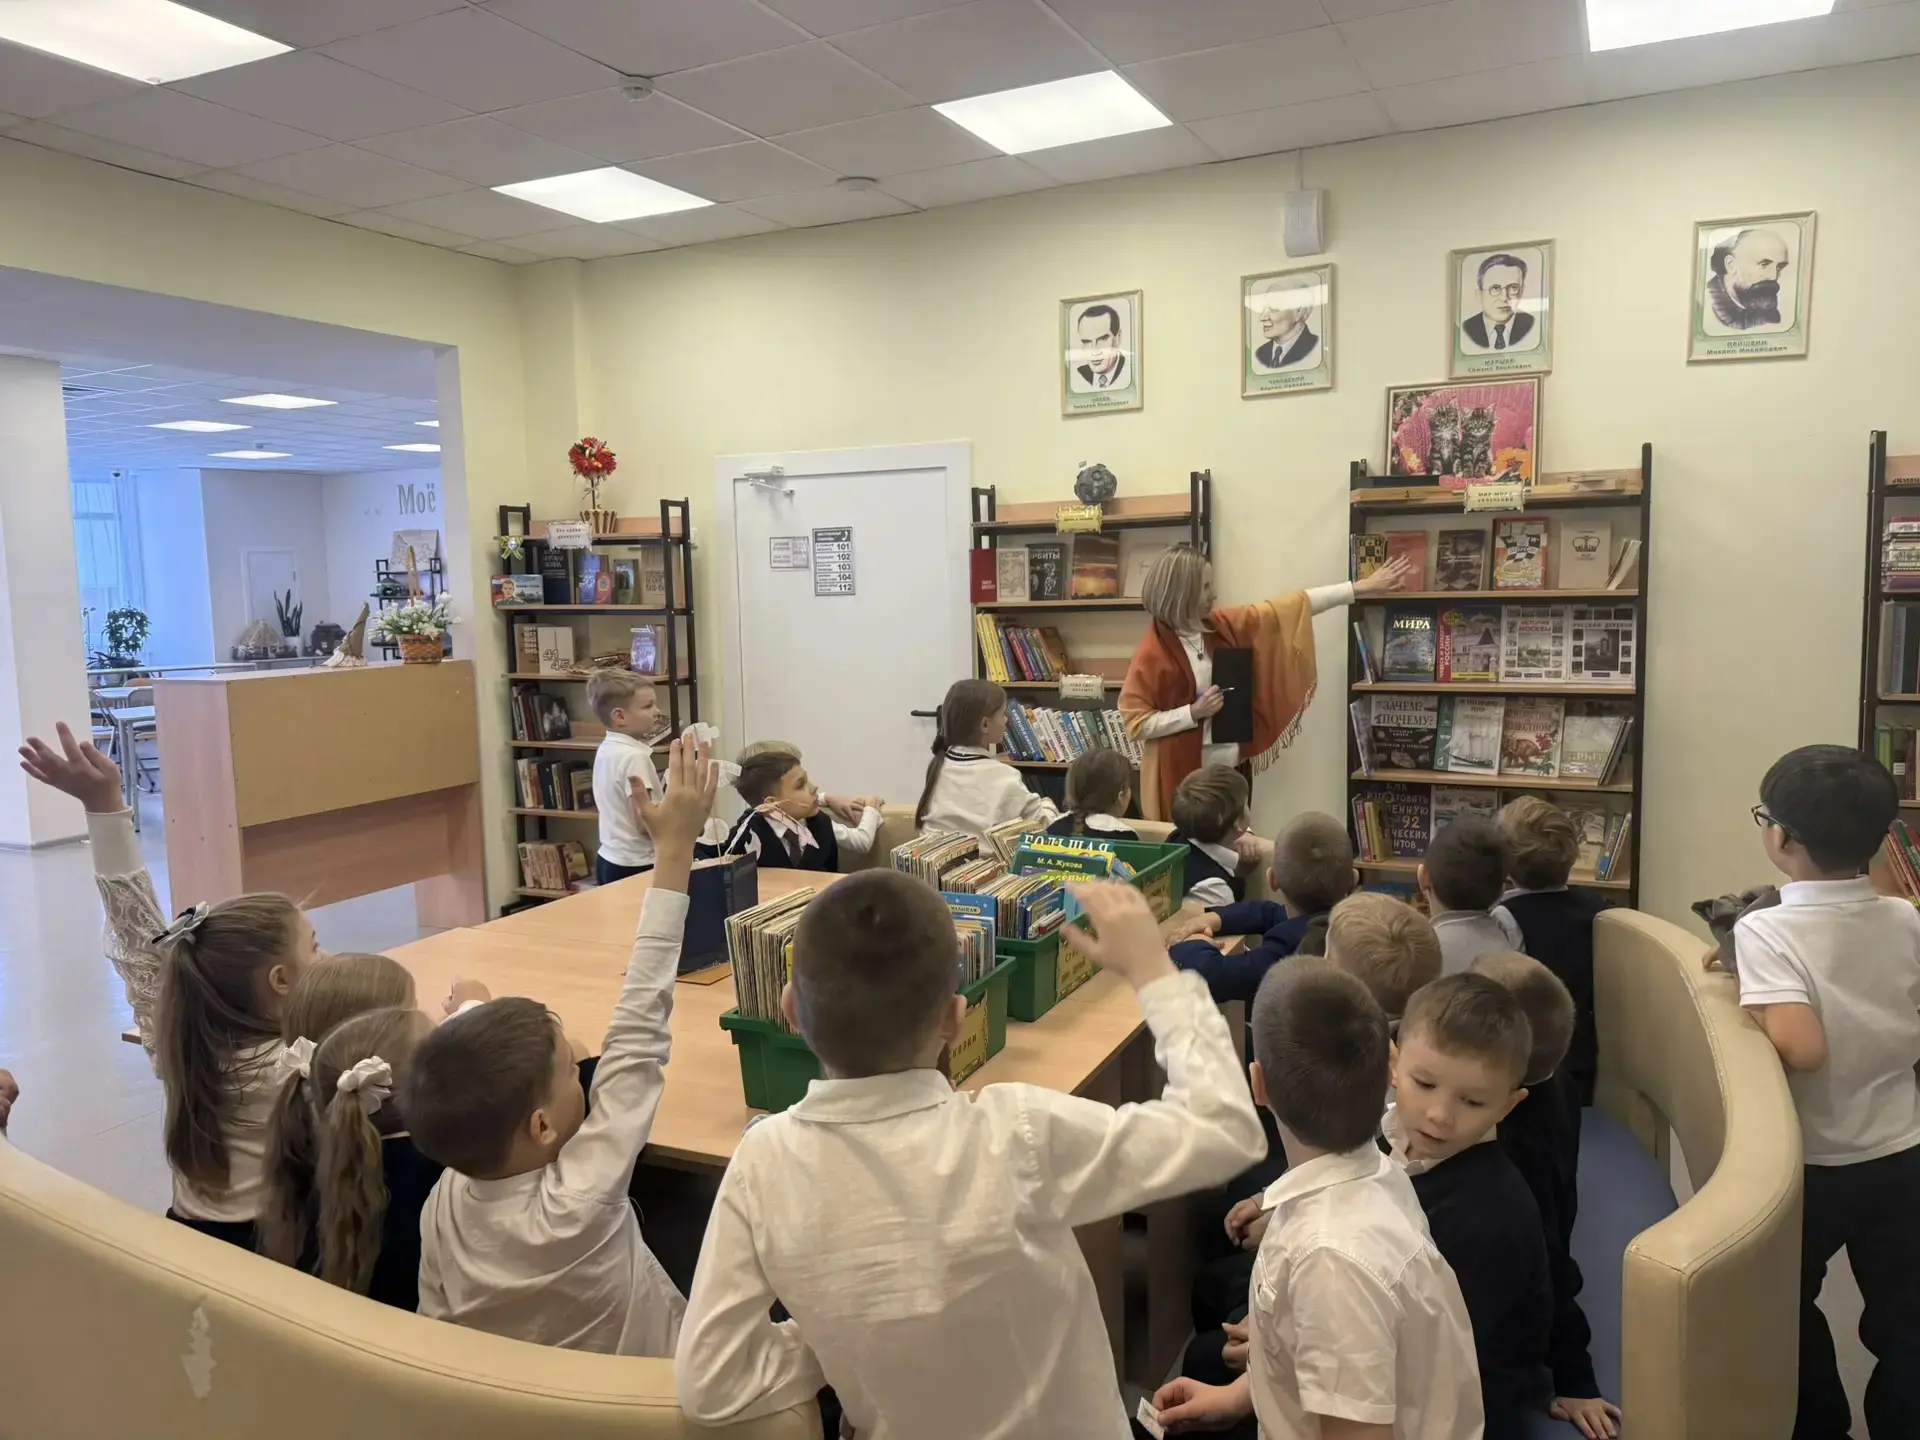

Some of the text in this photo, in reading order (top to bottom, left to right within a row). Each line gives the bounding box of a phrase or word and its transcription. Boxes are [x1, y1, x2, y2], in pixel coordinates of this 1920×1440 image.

[397, 483, 436, 515] Моё
[1031, 552, 1061, 560] РБИТЫ
[838, 573, 852, 581] 104
[839, 583, 852, 591] 112
[1393, 620, 1431, 629] МИРА
[543, 649, 559, 661] 41
[550, 659, 570, 671] 45
[1382, 700, 1423, 711] ЗАЧЕМ?
[1382, 714, 1434, 726] ПОЧЕМУ?
[1012, 708, 1036, 754] ЭНЦИКЛОПЕДИЯ
[1402, 816, 1420, 828] 92
[1391, 829, 1428, 840] ЧЕСКИХ
[1393, 840, 1416, 849] НТОВ
[1055, 860, 1083, 869] Жукова
[952, 1033, 977, 1058] КАЗКИ
